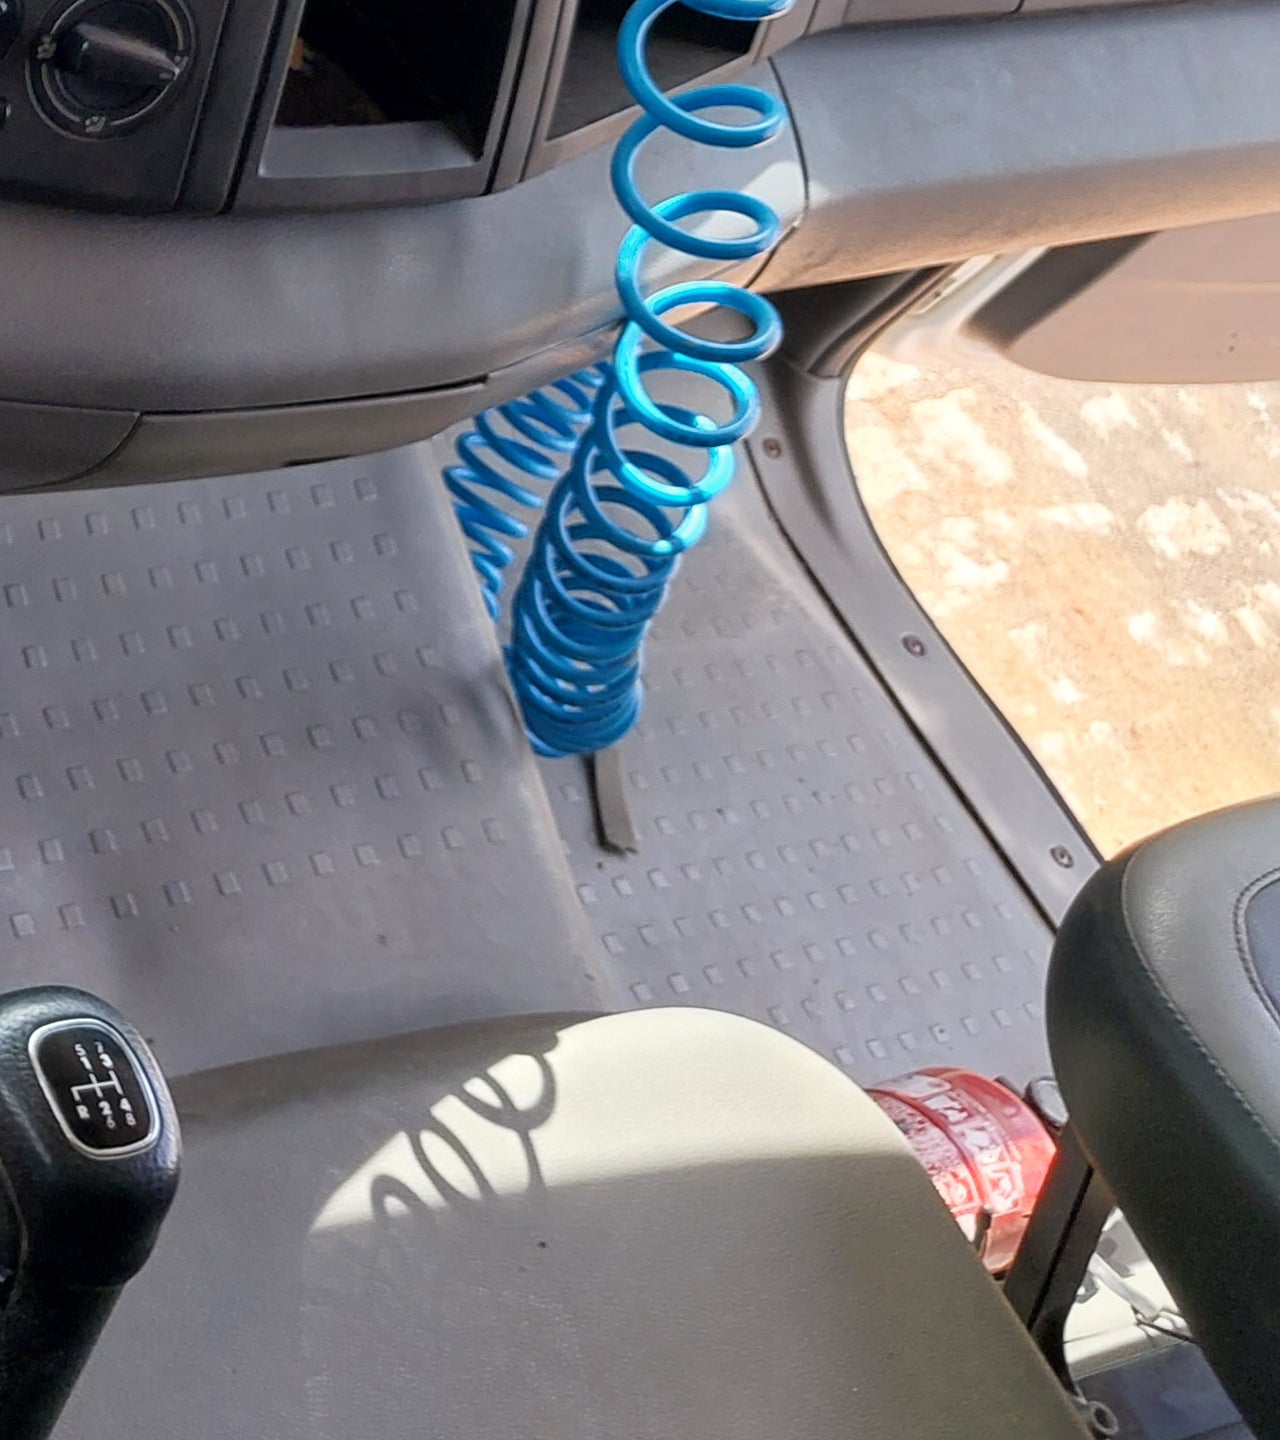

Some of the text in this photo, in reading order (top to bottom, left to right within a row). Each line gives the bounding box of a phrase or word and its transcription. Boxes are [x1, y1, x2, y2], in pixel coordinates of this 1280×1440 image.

[74, 1043, 86, 1057] 5
[80, 1053, 113, 1071] 1 3
[76, 1097, 132, 1119] R 2 4
[106, 1112, 137, 1129] 6 8
